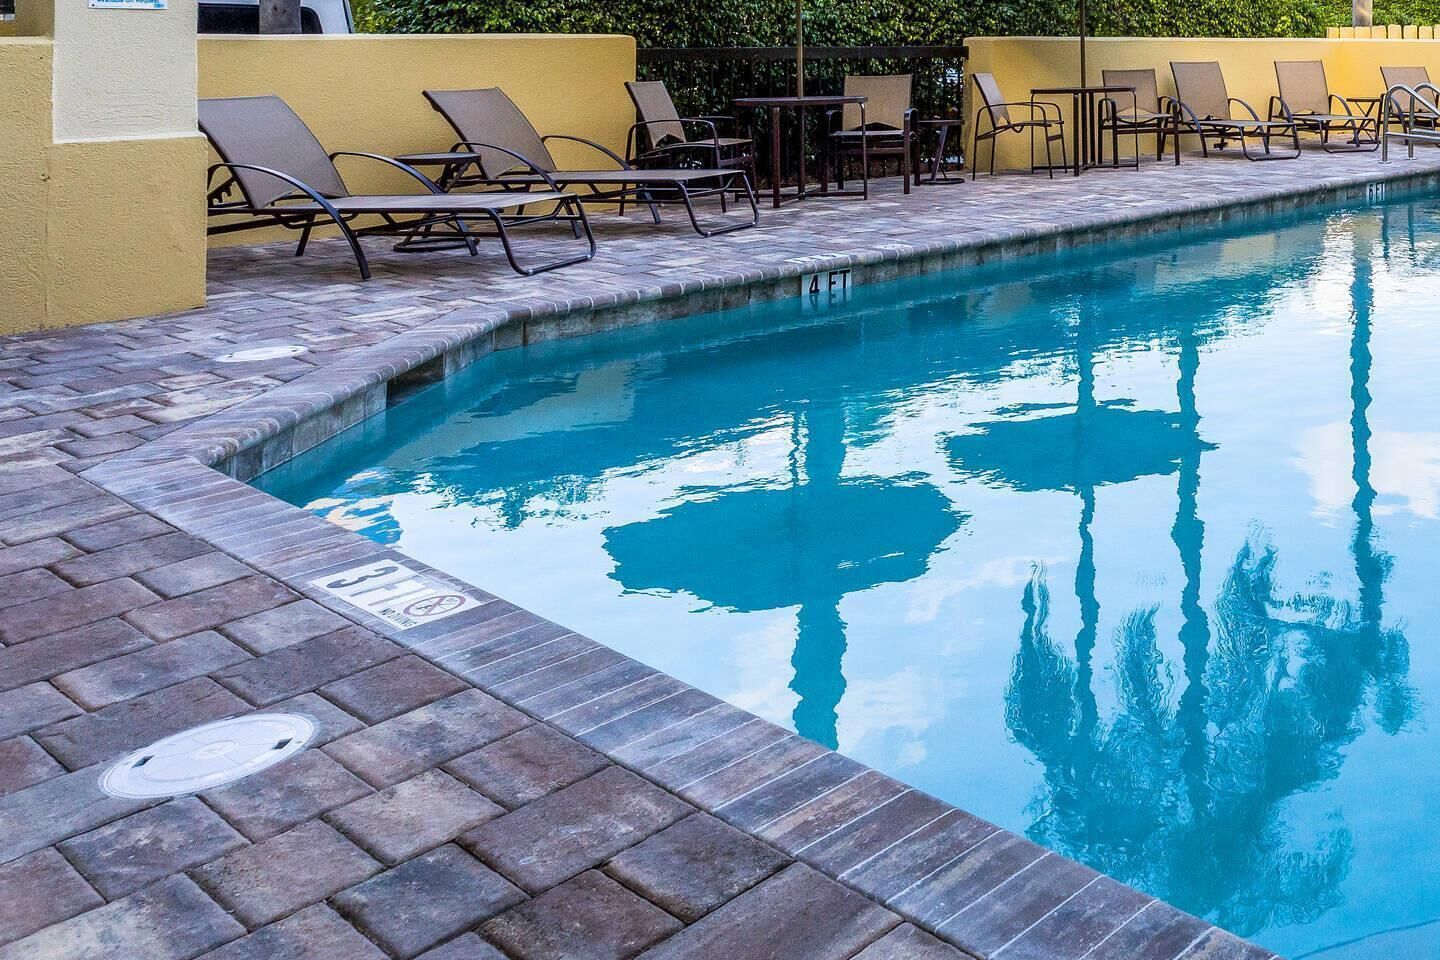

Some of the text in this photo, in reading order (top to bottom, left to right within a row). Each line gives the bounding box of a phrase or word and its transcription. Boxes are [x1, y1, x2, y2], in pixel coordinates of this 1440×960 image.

[809, 269, 851, 294] 4 FT
[326, 565, 443, 606] 3 FT
